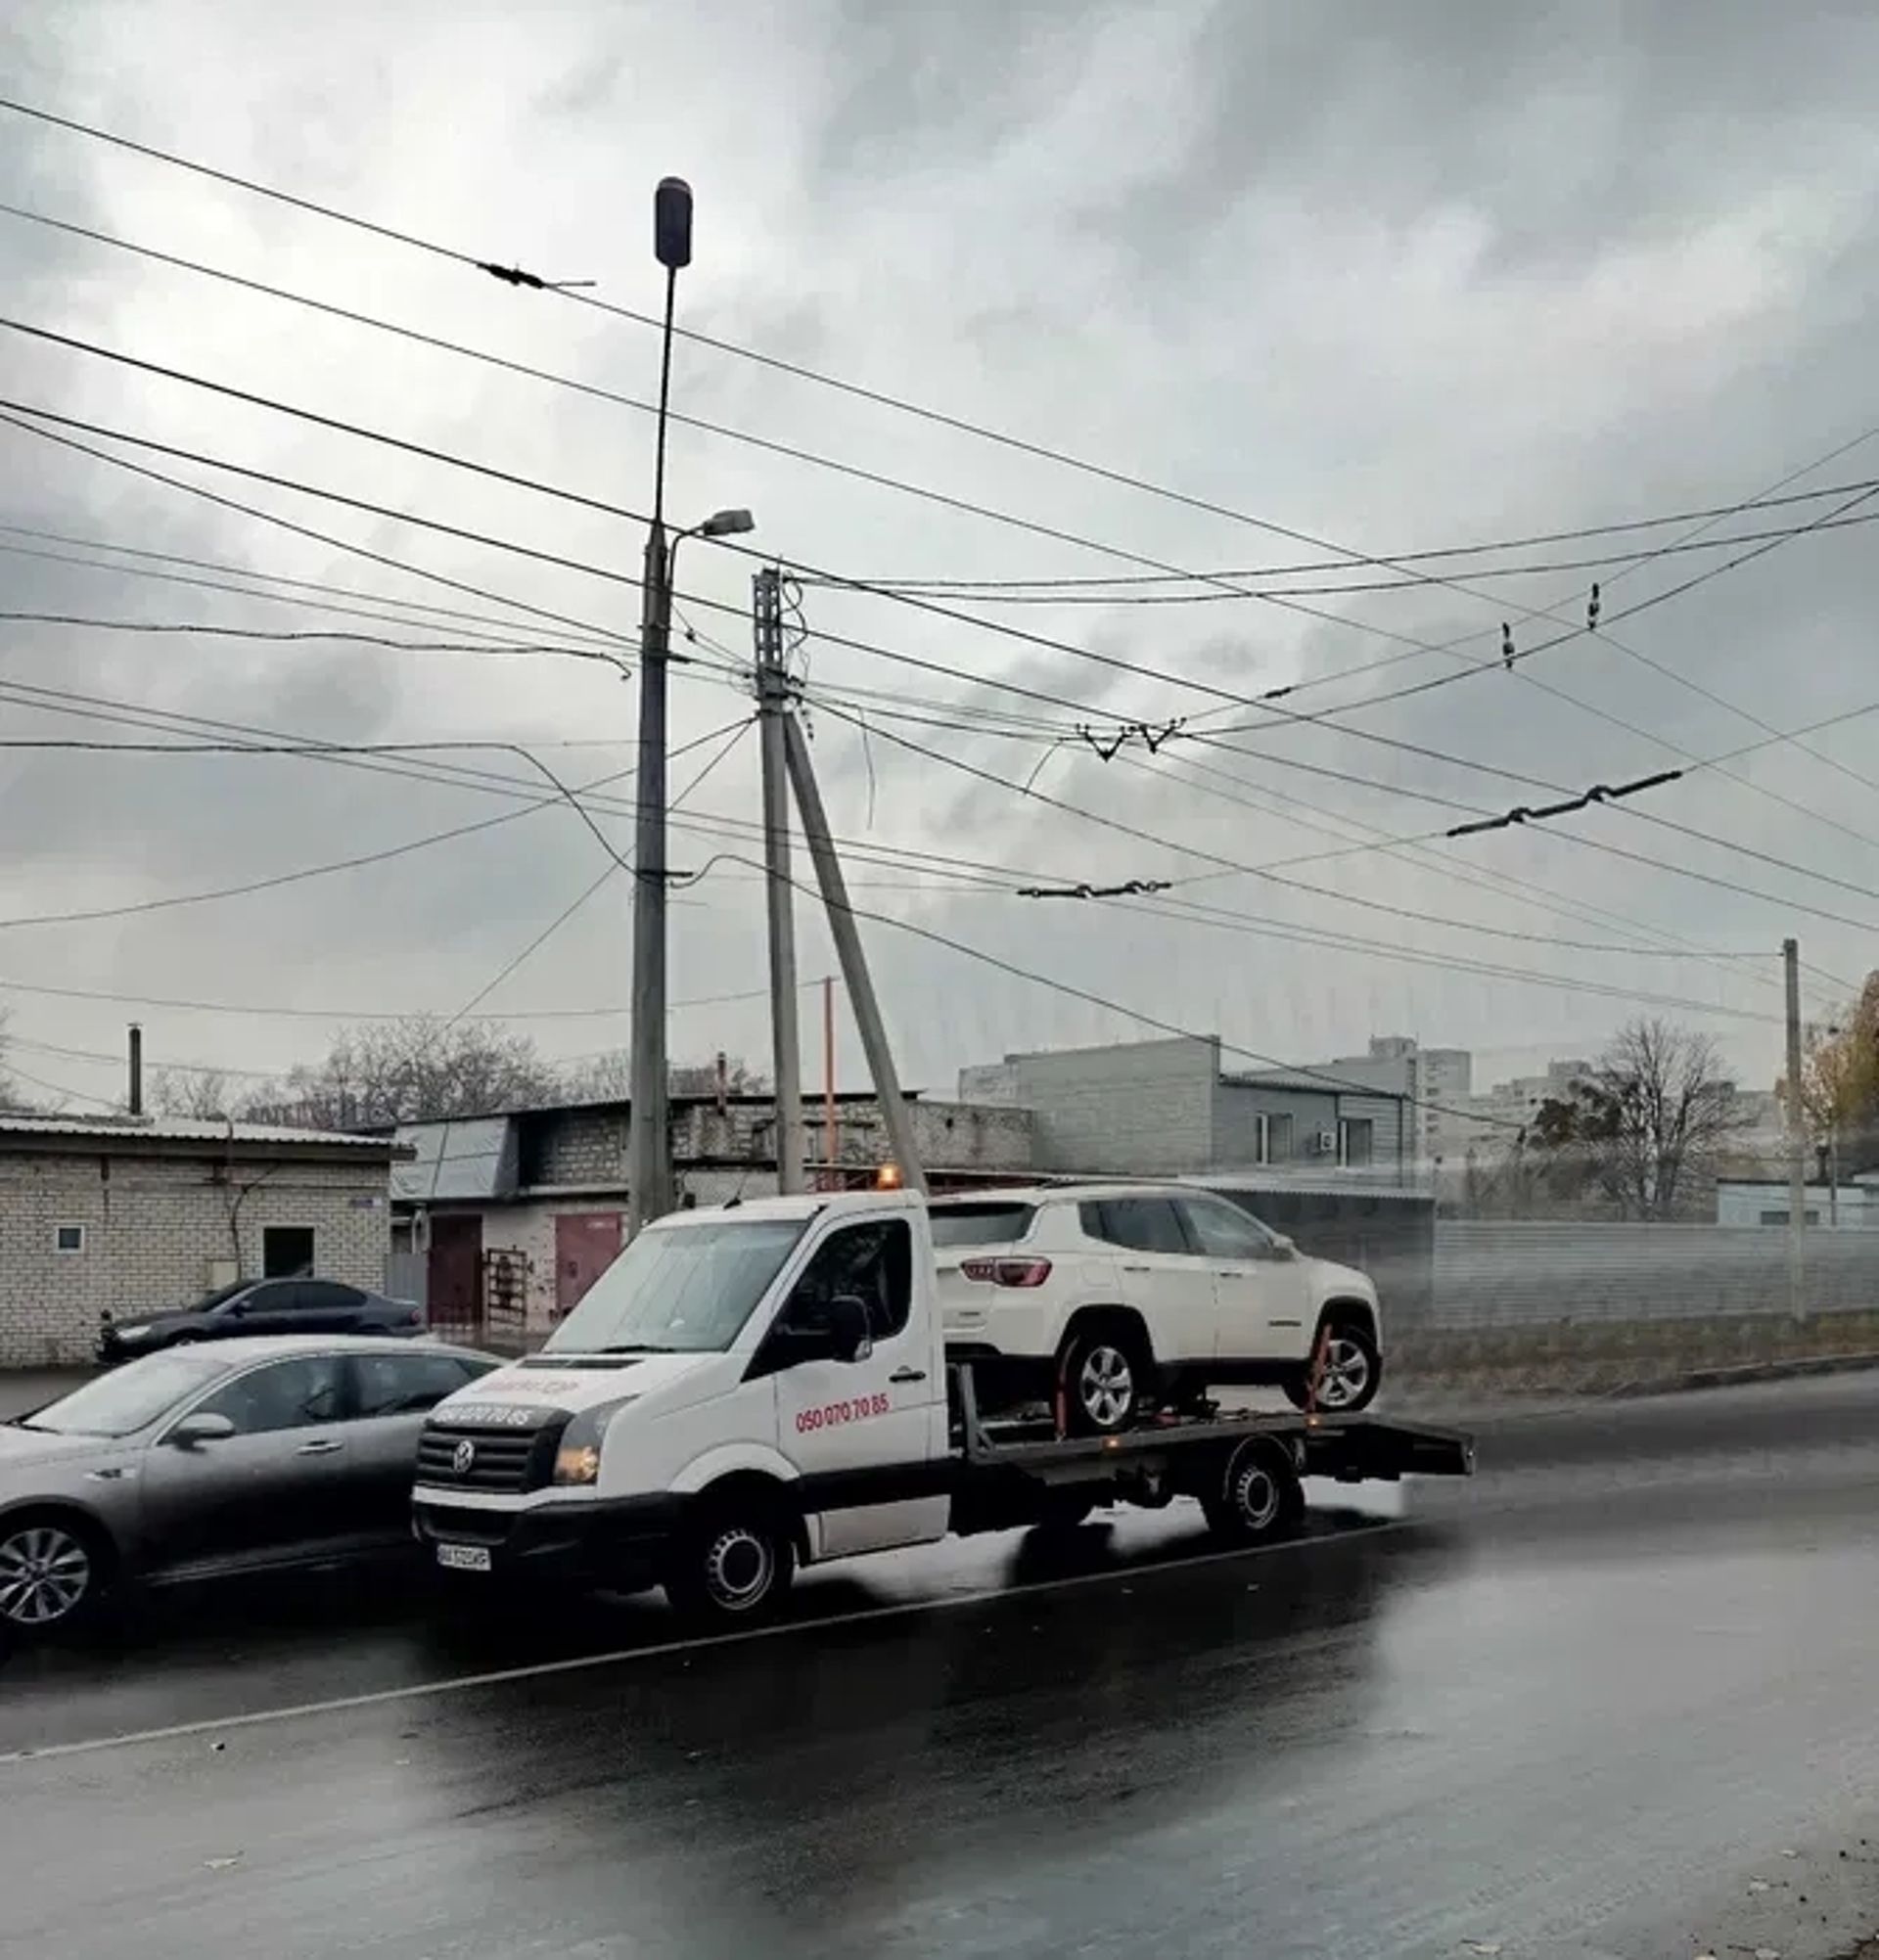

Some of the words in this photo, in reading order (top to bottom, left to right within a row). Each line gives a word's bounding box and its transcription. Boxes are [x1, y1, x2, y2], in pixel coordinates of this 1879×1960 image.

[796, 1409, 823, 1434] 050
[824, 1401, 850, 1425] 070
[851, 1397, 870, 1419] 70
